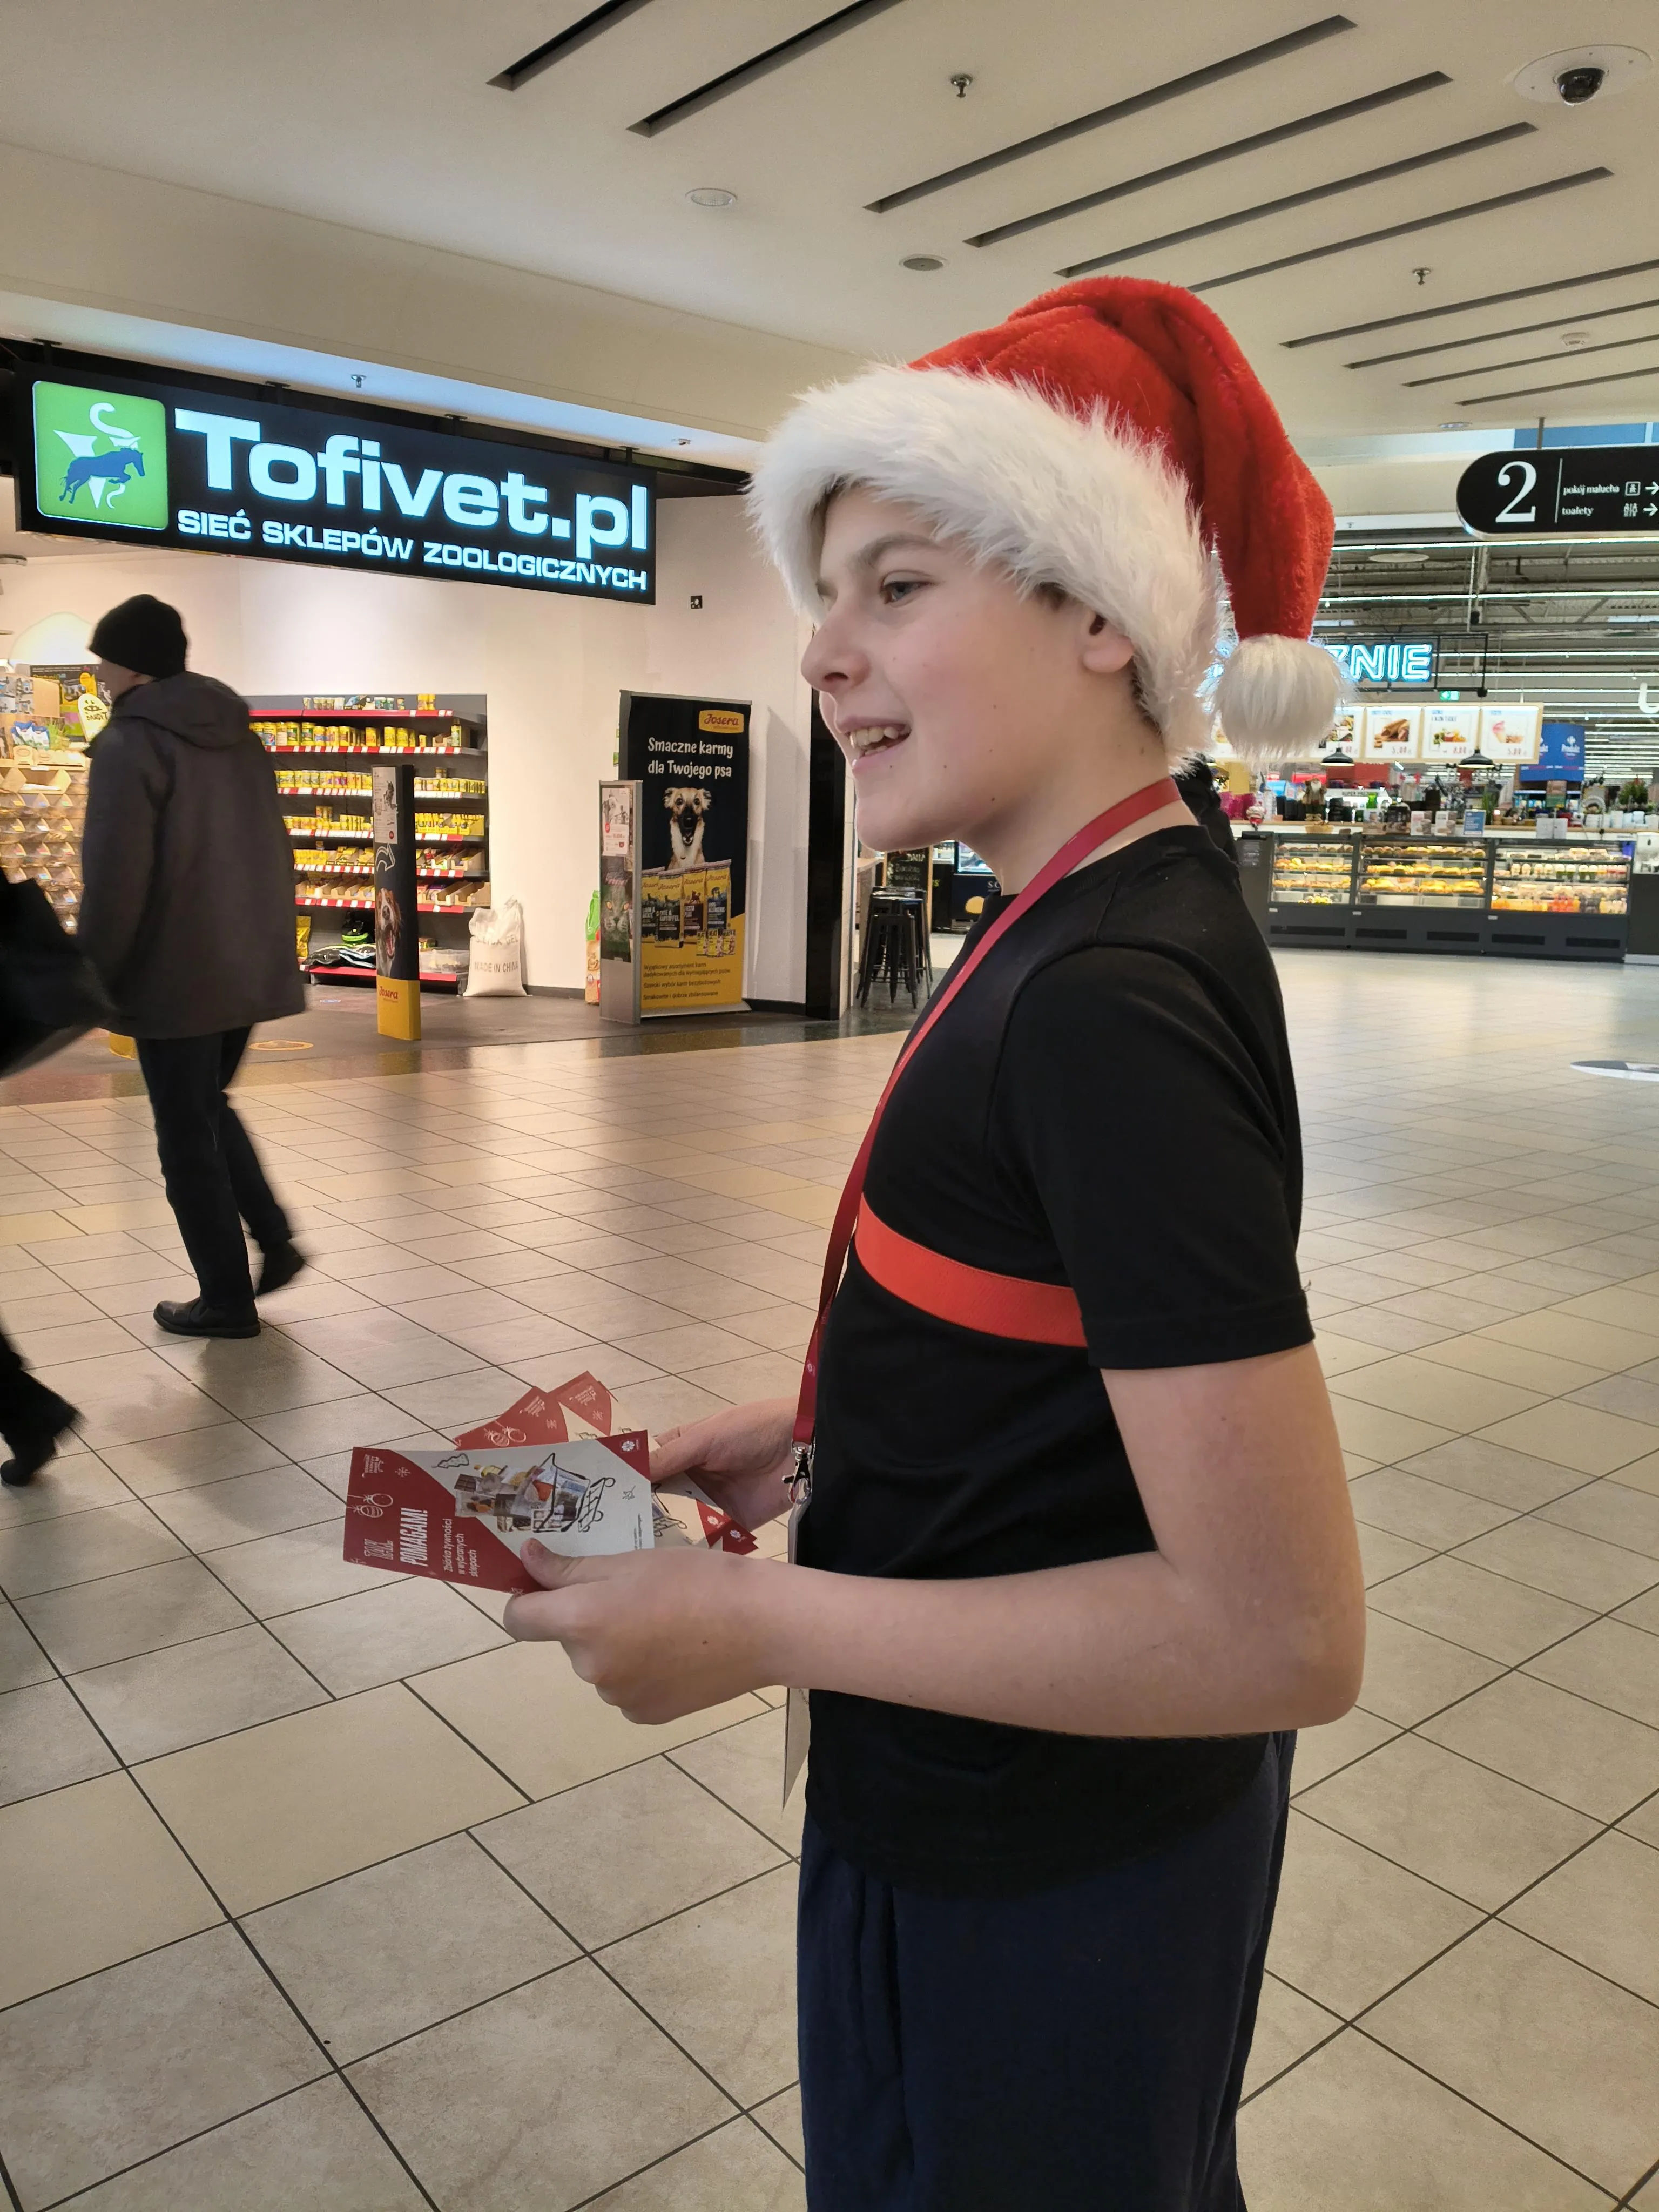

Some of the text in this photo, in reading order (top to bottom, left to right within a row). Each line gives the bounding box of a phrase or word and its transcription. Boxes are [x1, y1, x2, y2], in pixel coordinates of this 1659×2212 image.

[174, 408, 647, 559] Tofivet.pl
[1495, 461, 1537, 523] 2
[1563, 484, 1620, 496] pokój malucha
[1562, 506, 1594, 517] toalety
[177, 508, 647, 591] SIEĆ SKLEPÓW ZOOLOGICZNYCH
[704, 713, 739, 726] Josera
[648, 737, 733, 759] Smaczne karmy
[648, 760, 732, 779] dla Twojego psa
[494, 963, 500, 973] IN
[379, 986, 398, 999] Josera
[399, 1507, 428, 1567] POMAGAM!
[442, 1518, 454, 1572] Zbiórka żywności
[455, 1533, 466, 1569] wybranych
[468, 1549, 479, 1577] sklepach
